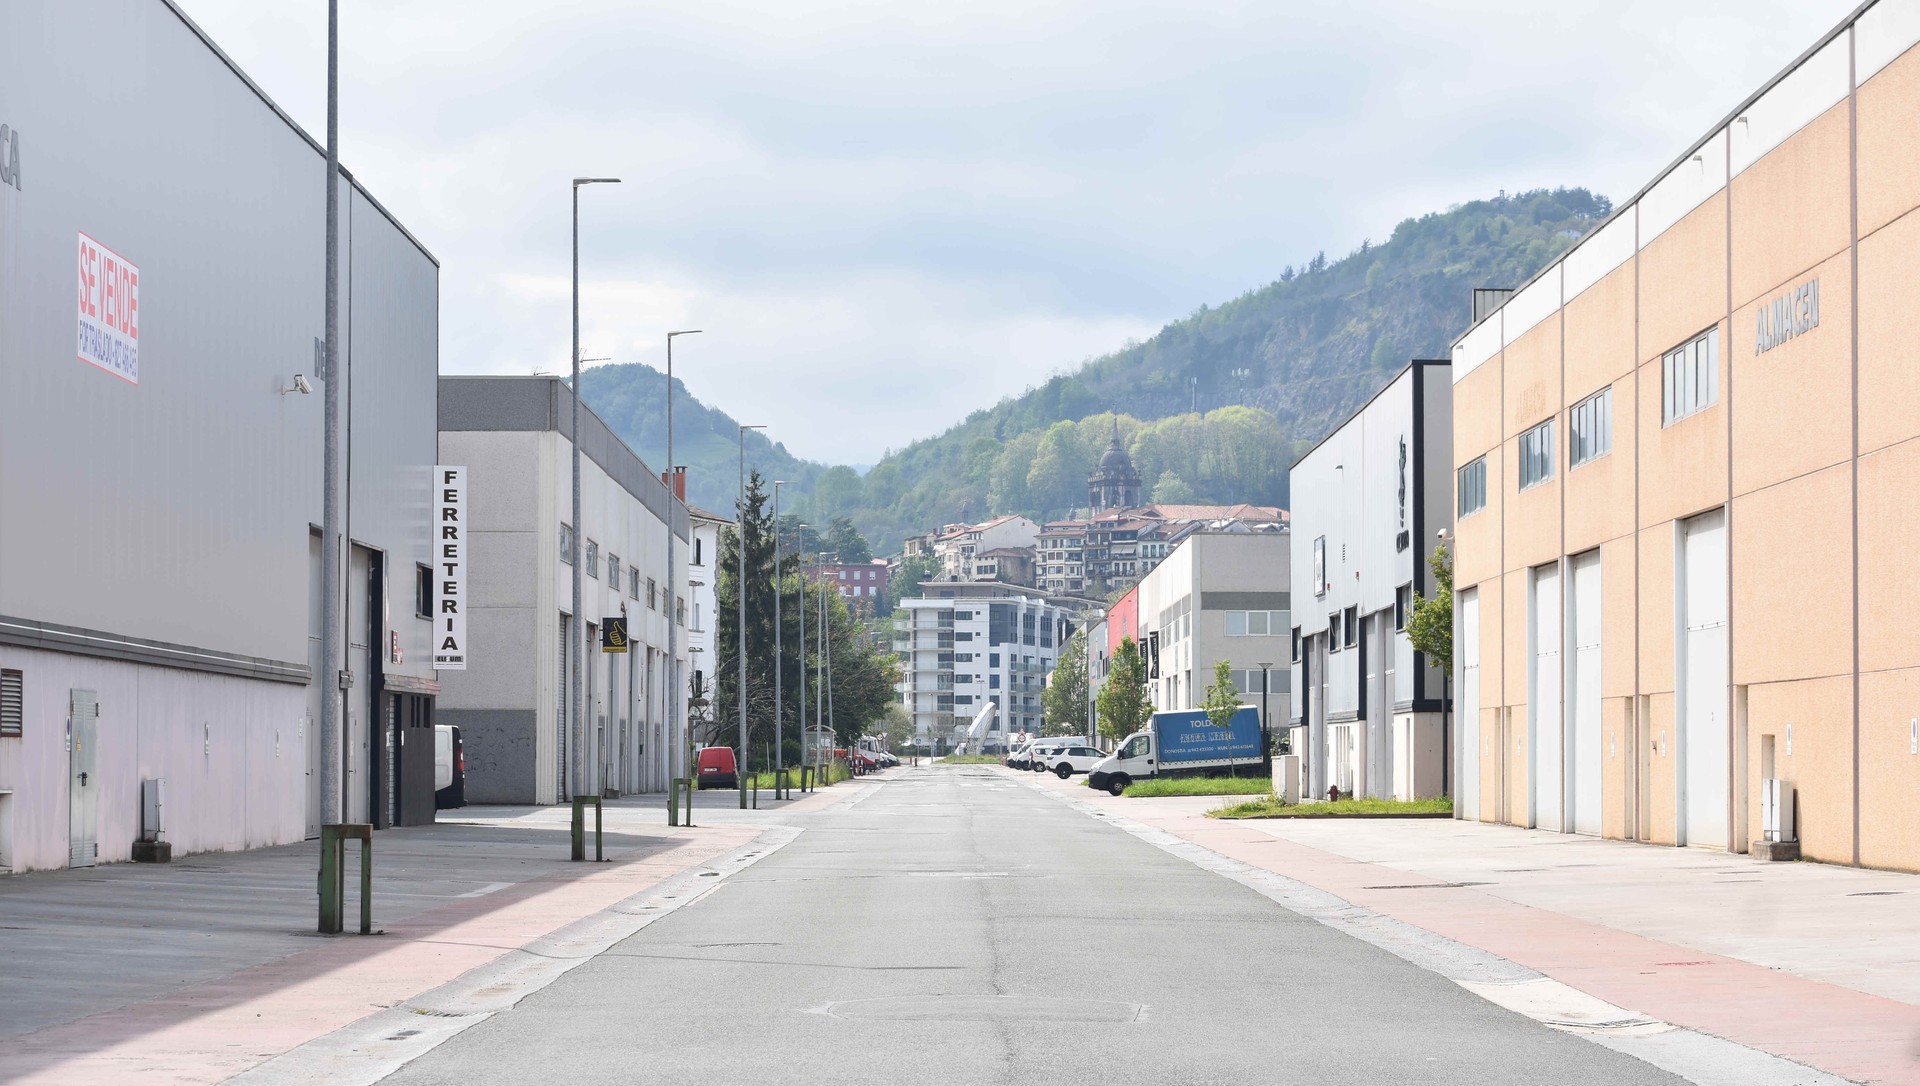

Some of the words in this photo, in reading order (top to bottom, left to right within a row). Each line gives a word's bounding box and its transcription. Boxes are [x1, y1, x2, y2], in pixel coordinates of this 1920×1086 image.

[79, 241, 97, 317] SE
[98, 252, 138, 340] VENDE
[1755, 277, 1820, 357] ALMACEN
[441, 470, 458, 651] FERRETERIA
